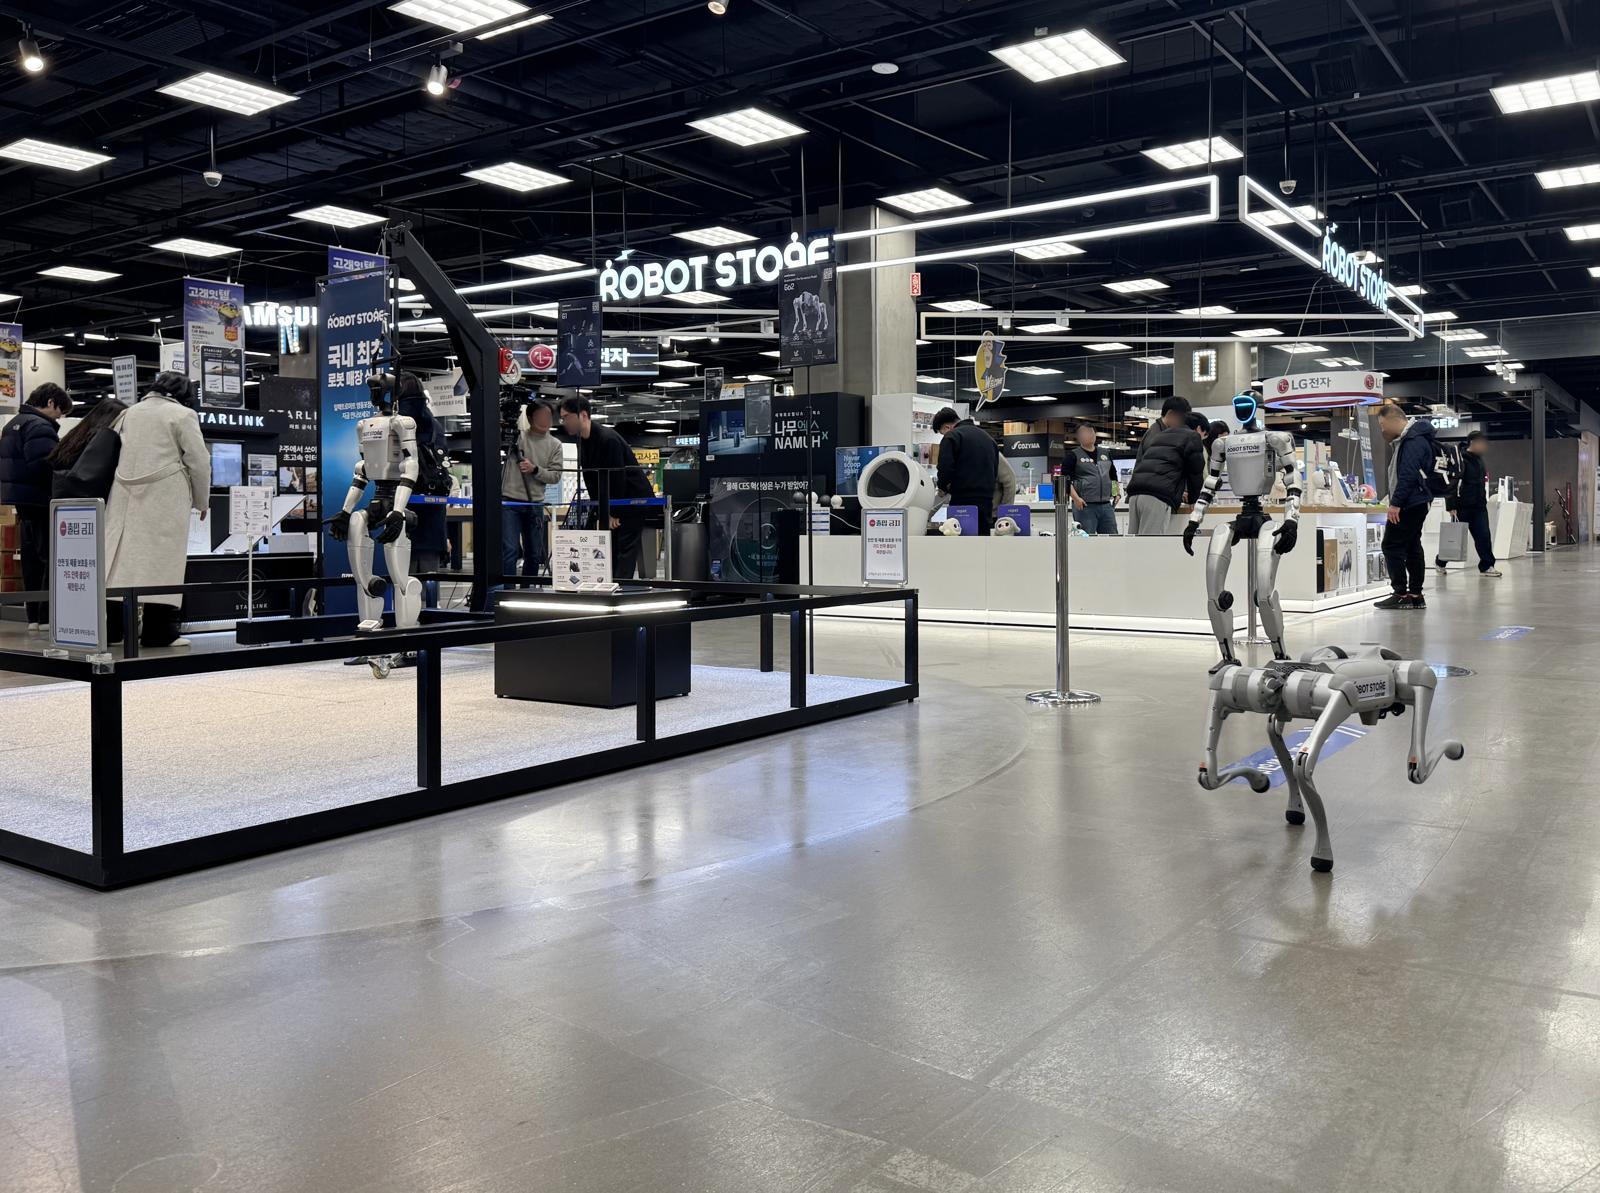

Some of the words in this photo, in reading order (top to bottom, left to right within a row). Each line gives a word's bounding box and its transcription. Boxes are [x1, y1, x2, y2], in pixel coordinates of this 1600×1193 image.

[1322, 226, 1360, 292] ROBOT
[1360, 264, 1388, 312] STORE
[599, 255, 709, 302] ROBOT
[784, 283, 795, 291] Go2
[327, 314, 356, 329] ROBOT
[356, 308, 384, 324] STORE
[328, 342, 354, 369] 국내
[327, 372, 345, 388] 로봇
[346, 369, 363, 387] 매장
[1292, 377, 1332, 391] LG전자
[198, 412, 264, 427] TARLINK
[775, 420, 820, 436] 나무엑스
[739, 482, 750, 490] CES
[774, 481, 787, 490] 누가
[67, 522, 80, 535] 출입
[81, 522, 94, 535] 금지
[1370, 680, 1386, 692] STORE
